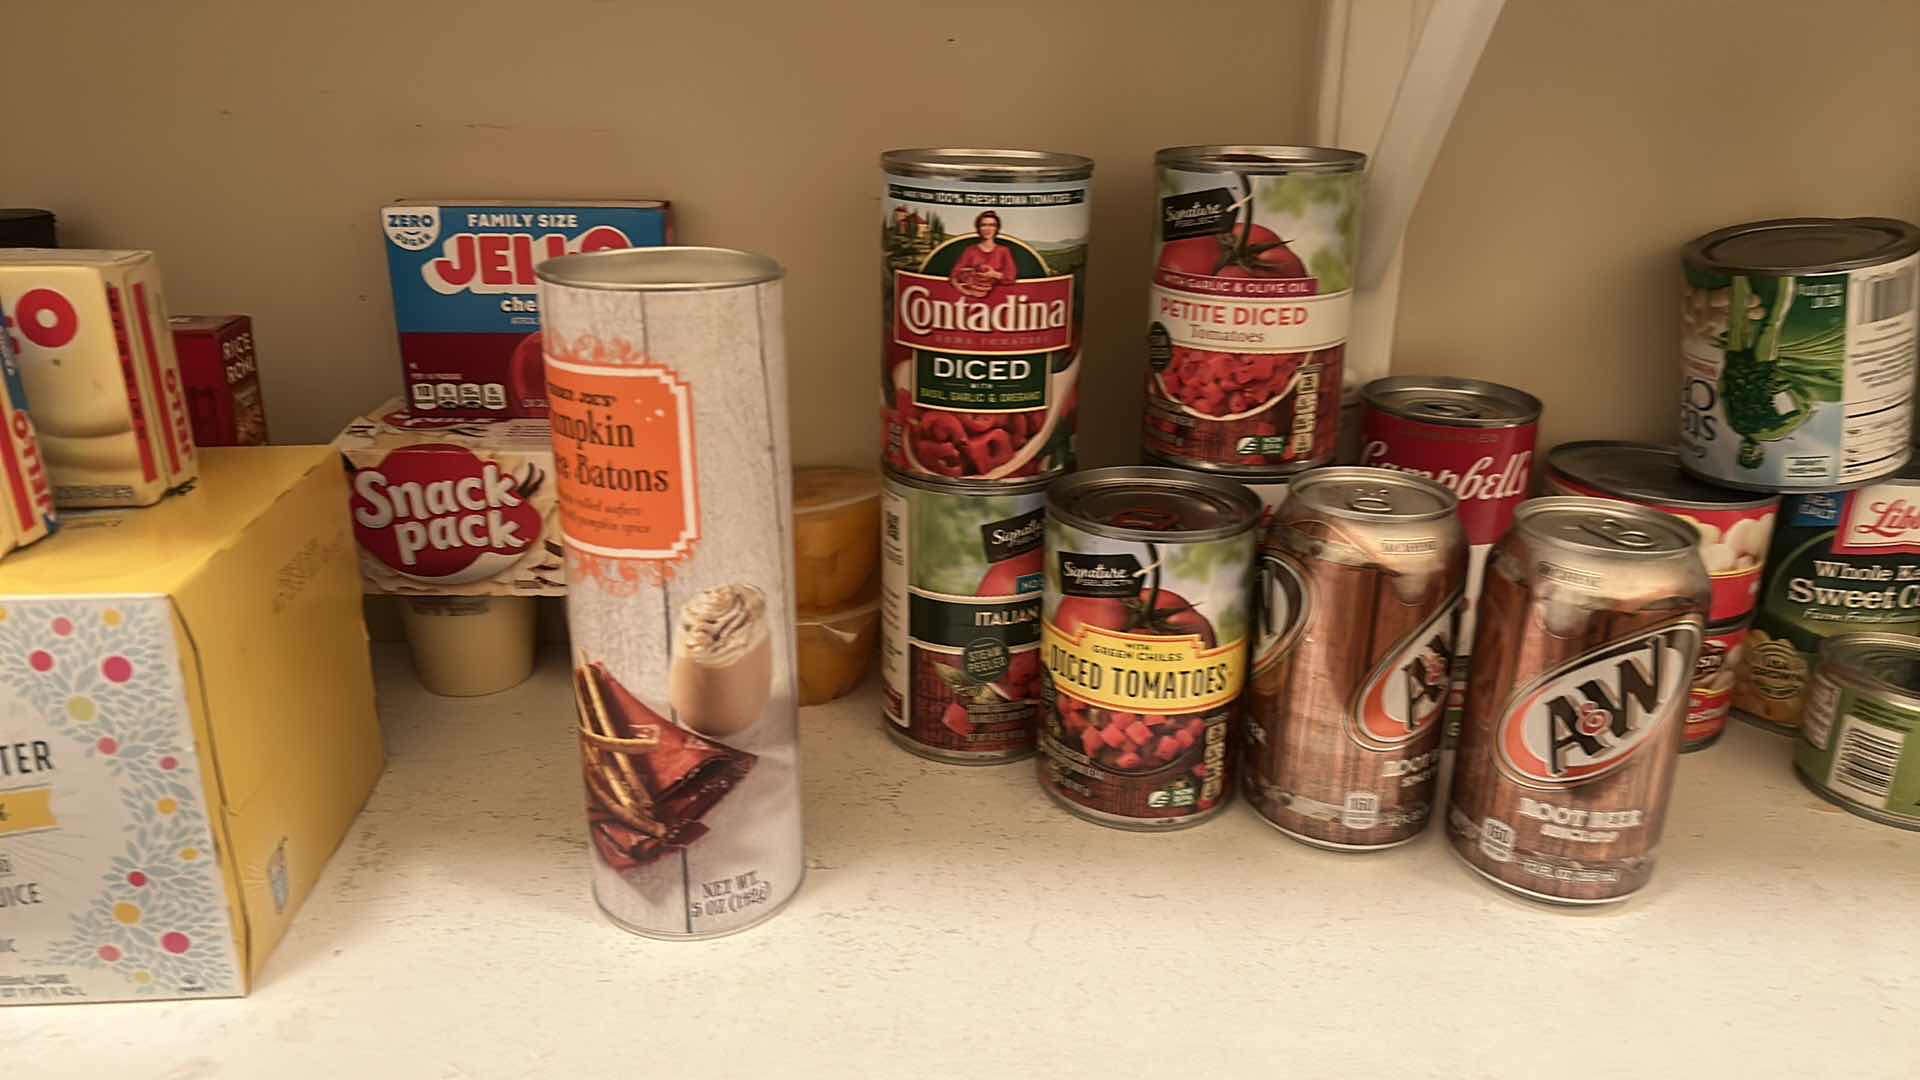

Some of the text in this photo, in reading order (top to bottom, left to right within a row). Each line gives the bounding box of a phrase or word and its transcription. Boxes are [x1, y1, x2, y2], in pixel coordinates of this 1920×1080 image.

[388, 214, 434, 228] ZERO
[467, 214, 578, 228] FAMILY SIZE
[1288, 282, 1310, 292] OIL
[901, 285, 1066, 335] Contadina
[1160, 297, 1309, 326] PETITE DICED
[933, 357, 1032, 380] DICED
[576, 453, 670, 493] Batons
[355, 464, 522, 529] Snack
[394, 510, 533, 566] pack
[1813, 560, 1894, 581] Whole
[1787, 577, 1898, 609] Sweet
[1092, 644, 1185, 662] GREEN CHILES
[1050, 644, 1228, 700] DICED TOMATOES
[1545, 633, 1665, 775] A&W
